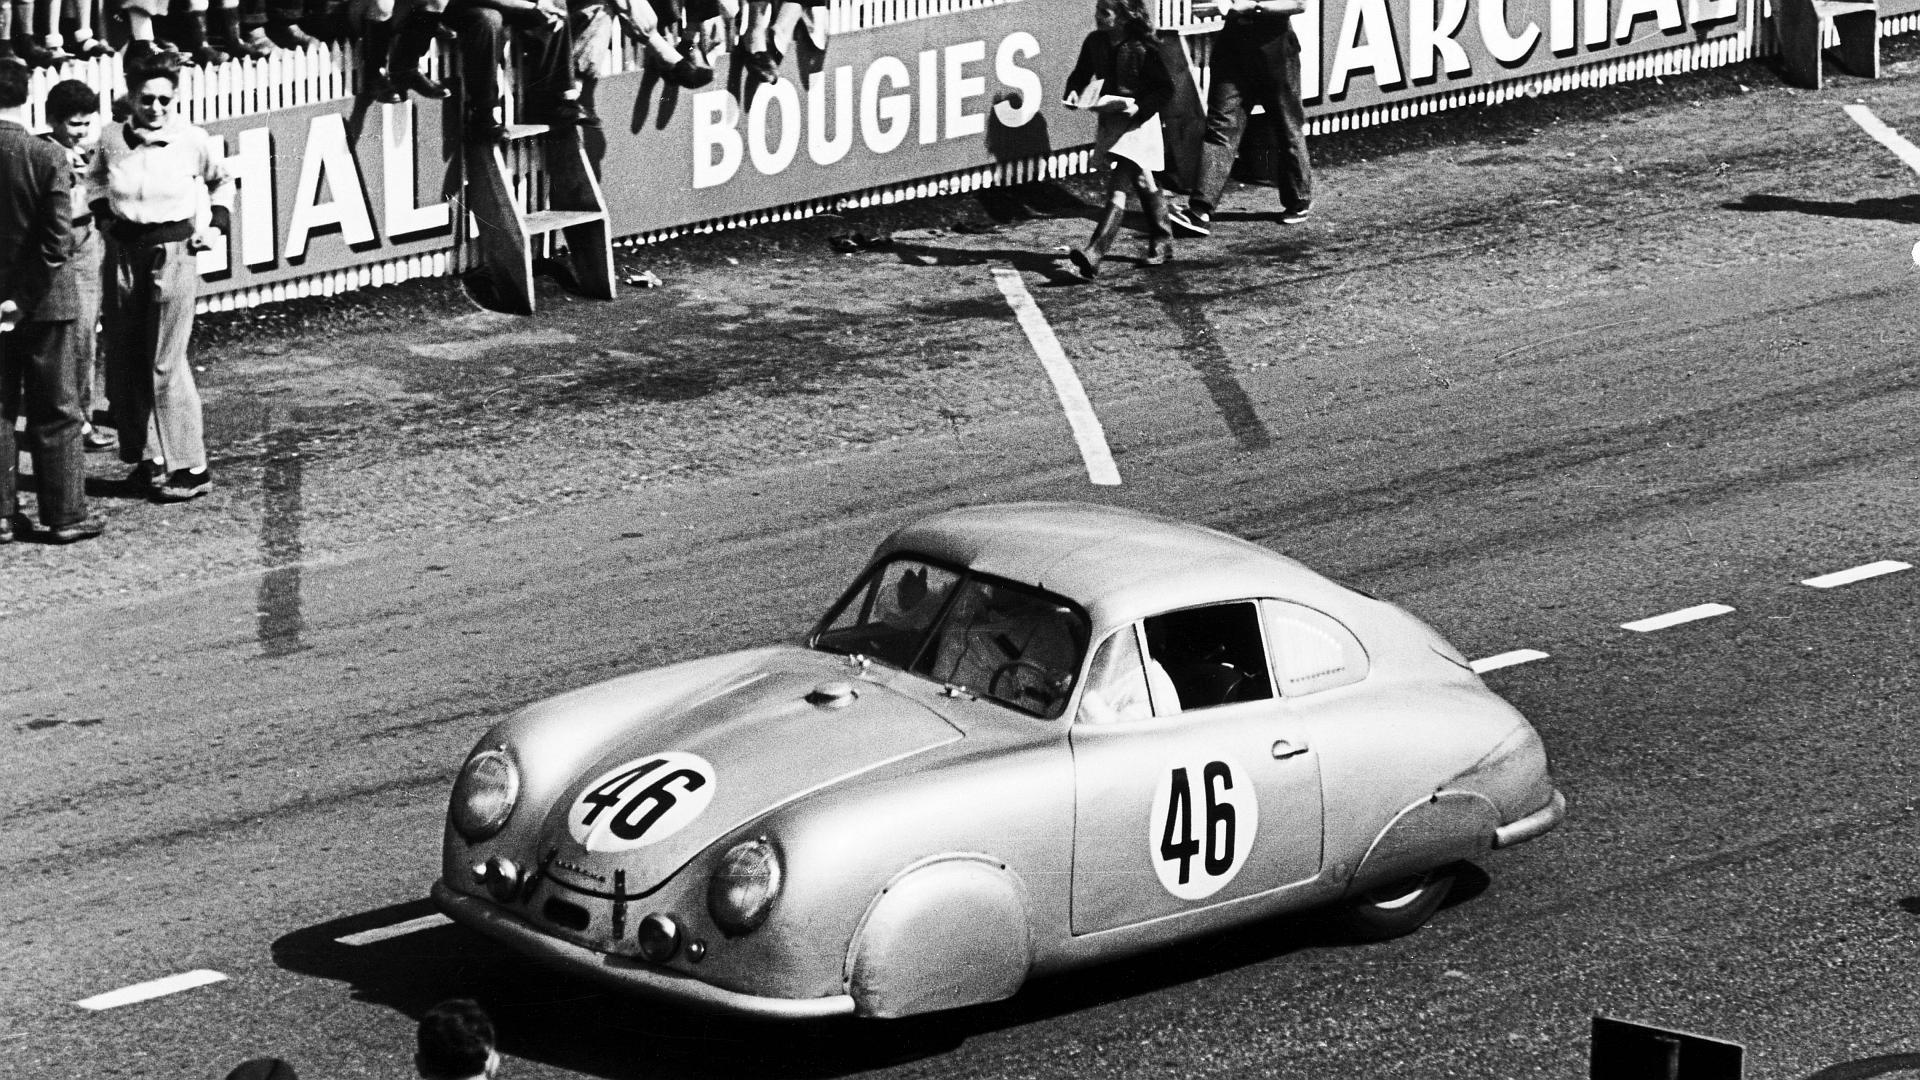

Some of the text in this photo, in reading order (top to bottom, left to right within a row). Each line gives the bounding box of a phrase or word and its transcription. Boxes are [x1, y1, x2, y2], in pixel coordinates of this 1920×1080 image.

[692, 31, 1043, 189] BOUGIES
[581, 758, 706, 840] 46
[1160, 760, 1236, 885] 46
